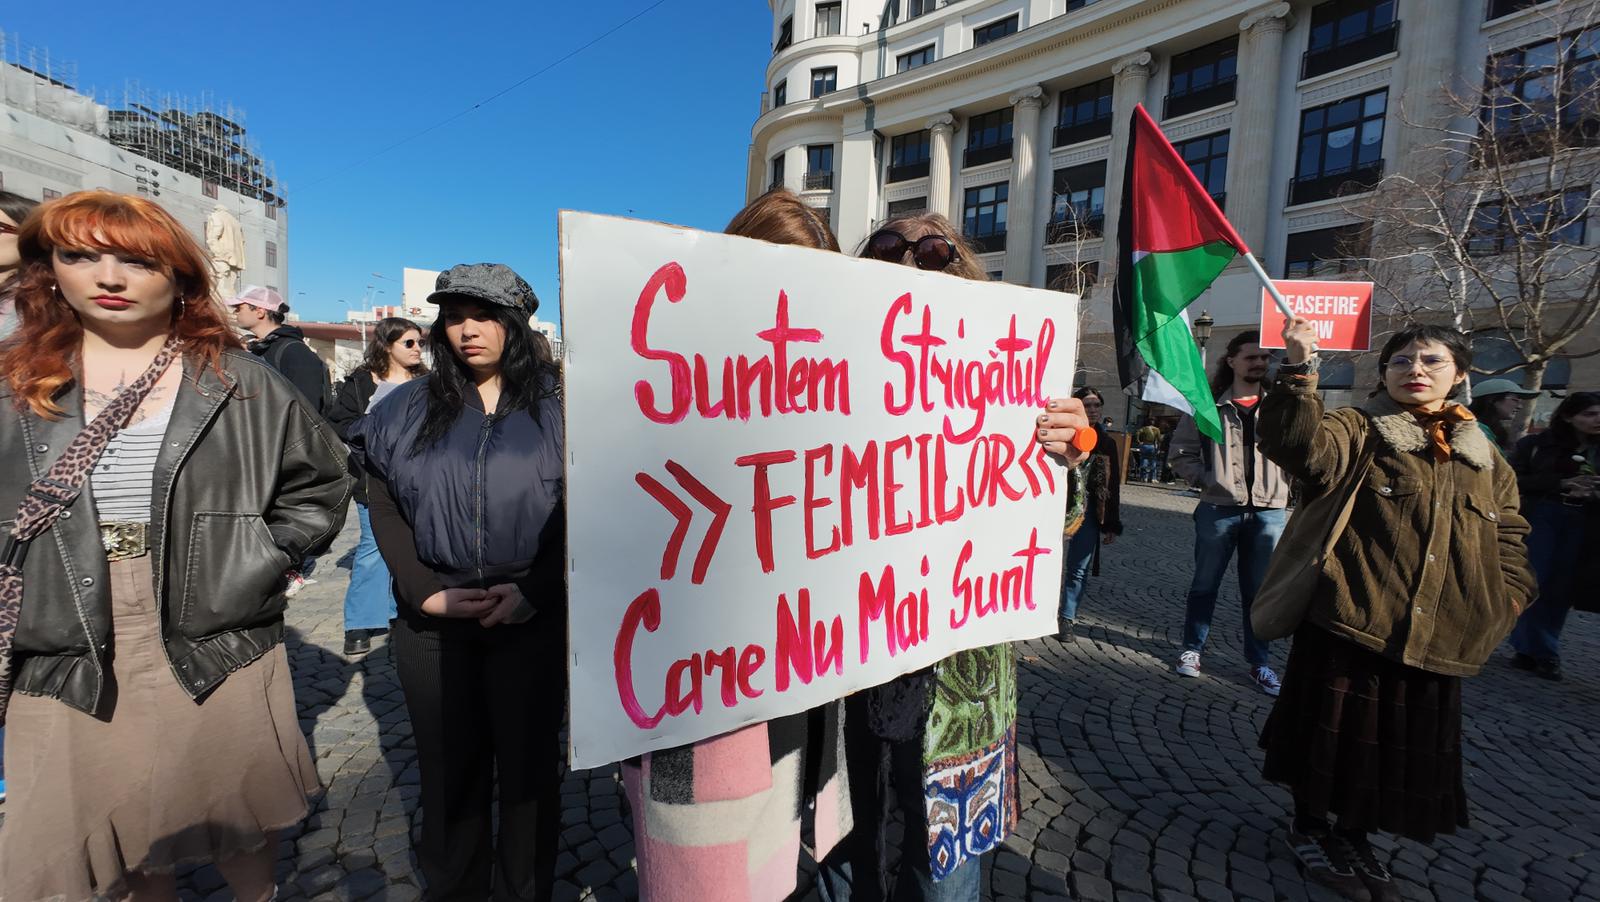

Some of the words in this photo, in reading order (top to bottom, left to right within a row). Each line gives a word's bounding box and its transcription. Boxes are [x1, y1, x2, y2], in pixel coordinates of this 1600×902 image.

[630, 260, 851, 425] Suntem
[1307, 319, 1334, 340] OW
[613, 587, 766, 730] Care
[775, 587, 844, 693] Nu
[858, 554, 931, 665] Mai
[949, 527, 1053, 630] Sunt
